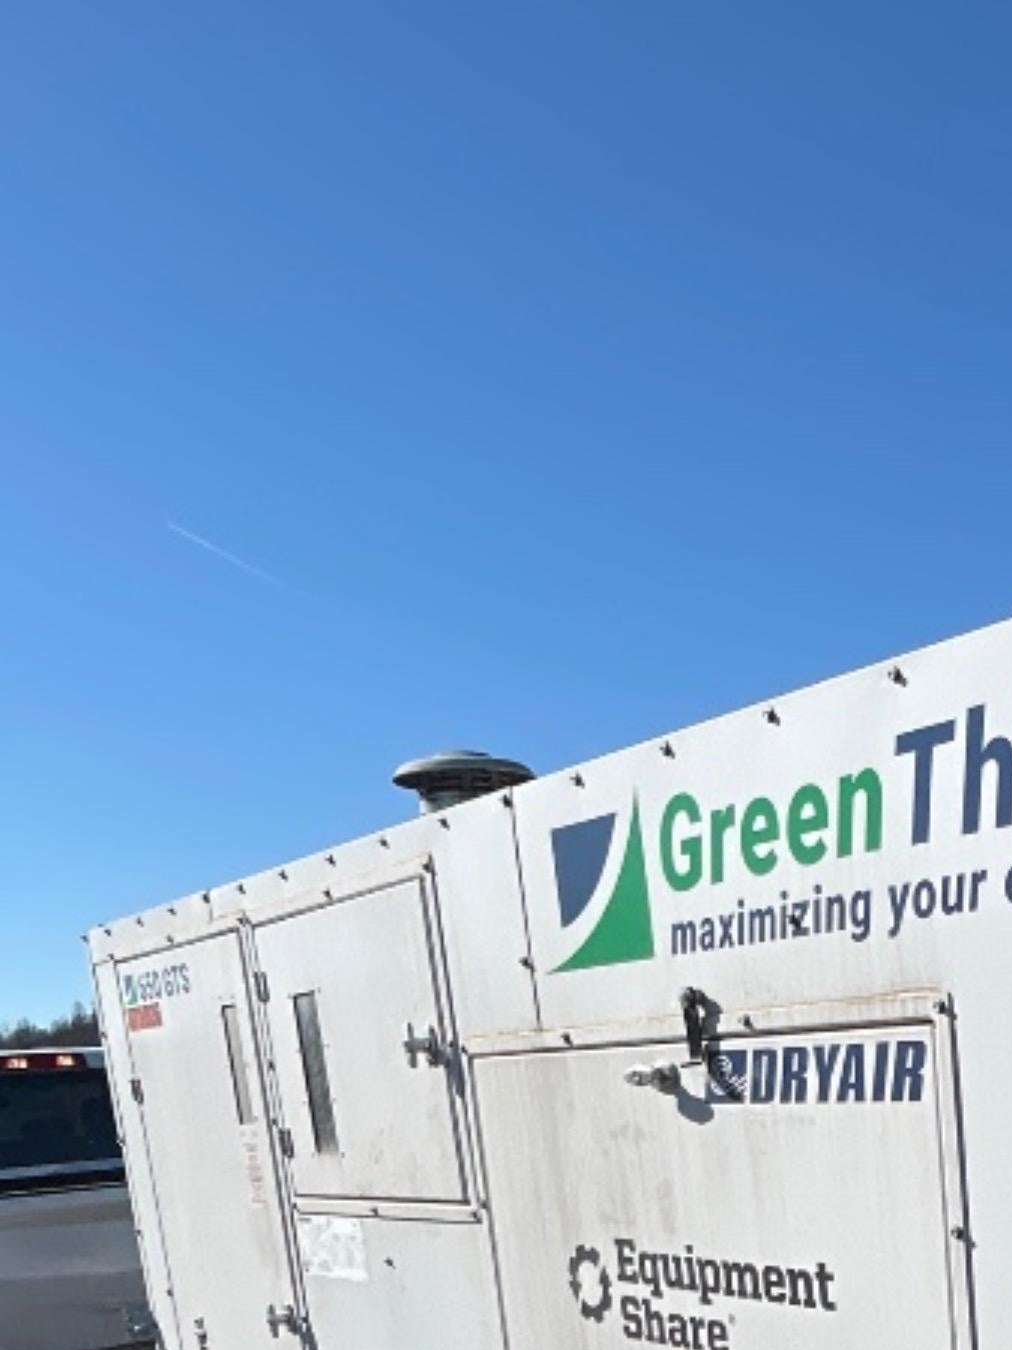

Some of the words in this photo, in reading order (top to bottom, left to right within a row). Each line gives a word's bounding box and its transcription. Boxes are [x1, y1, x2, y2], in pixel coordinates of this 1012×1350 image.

[670, 884, 871, 955] maximizing
[887, 868, 988, 938] your
[748, 1039, 928, 1104] DRYAIR
[613, 1238, 837, 1312] Equipment
